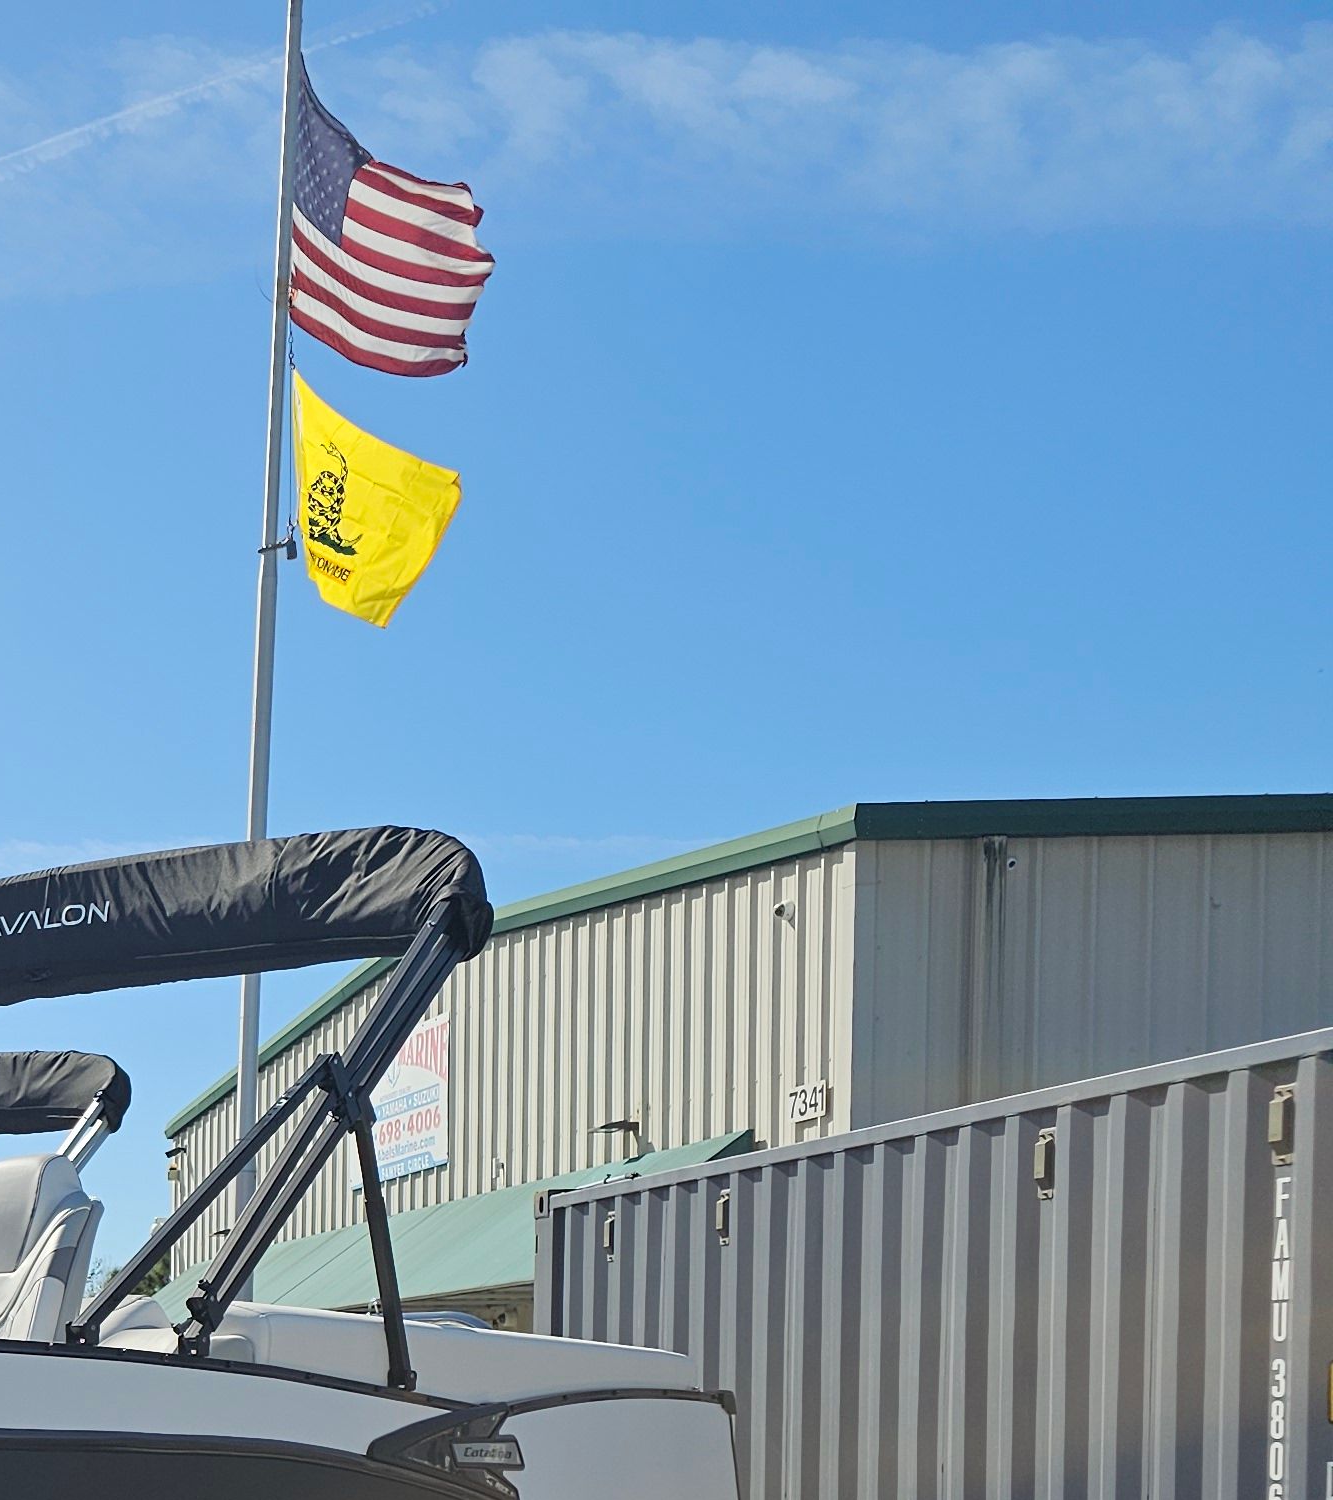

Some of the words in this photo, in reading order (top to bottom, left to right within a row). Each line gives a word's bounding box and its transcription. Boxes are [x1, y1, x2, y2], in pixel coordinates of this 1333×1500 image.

[413, 1086, 439, 1106] SUZUKI
[789, 1084, 825, 1119] 7341
[1271, 1176, 1292, 1342] FAMU
